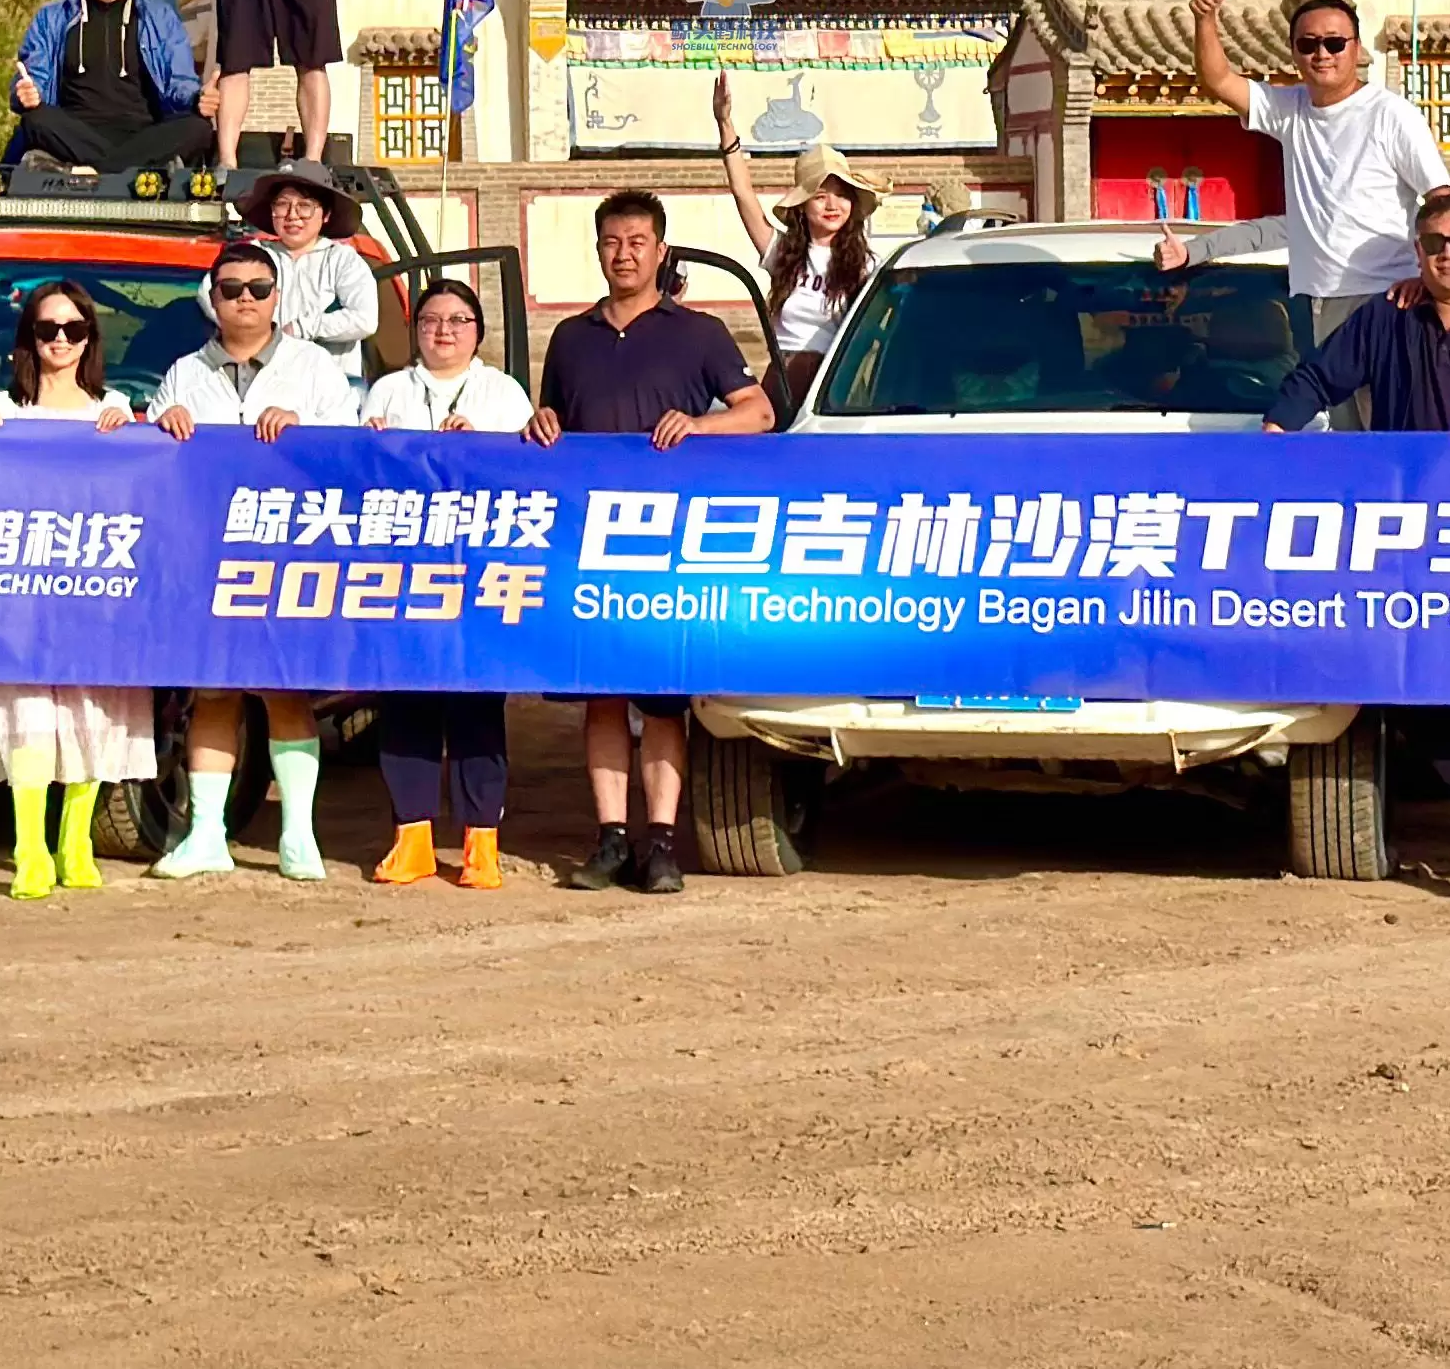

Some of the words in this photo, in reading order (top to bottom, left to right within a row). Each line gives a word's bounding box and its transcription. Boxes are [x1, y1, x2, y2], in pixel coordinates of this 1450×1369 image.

[223, 487, 558, 548] 鲸头鹳科技
[211, 560, 547, 624] 2025年
[572, 583, 728, 621] Shoebill
[741, 586, 966, 632] Technology
[978, 589, 1105, 633] Bagan
[1118, 588, 1196, 626] Jilin
[1211, 590, 1346, 628] Desert
